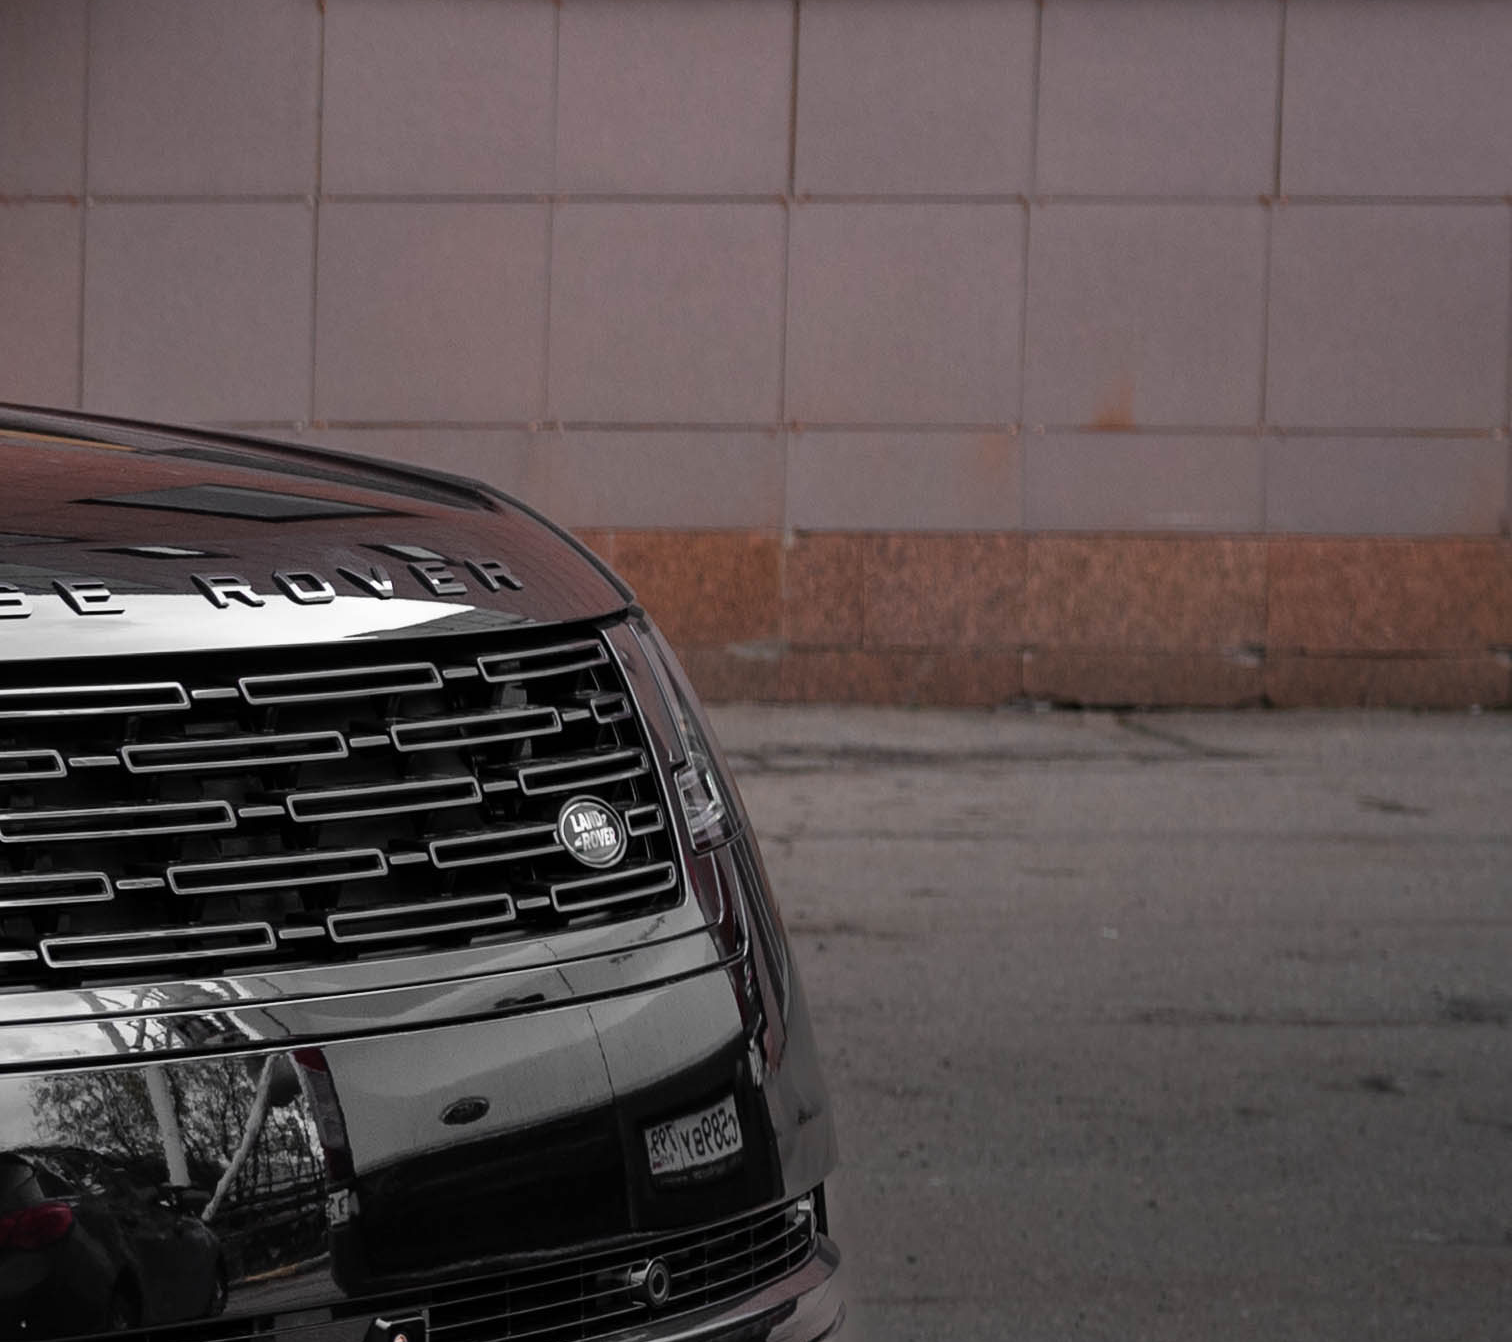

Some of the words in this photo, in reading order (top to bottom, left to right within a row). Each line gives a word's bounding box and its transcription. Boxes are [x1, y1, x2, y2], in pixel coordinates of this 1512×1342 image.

[189, 558, 524, 610] ROVER
[569, 810, 603, 833] LAND
[581, 826, 617, 852] ROVER
